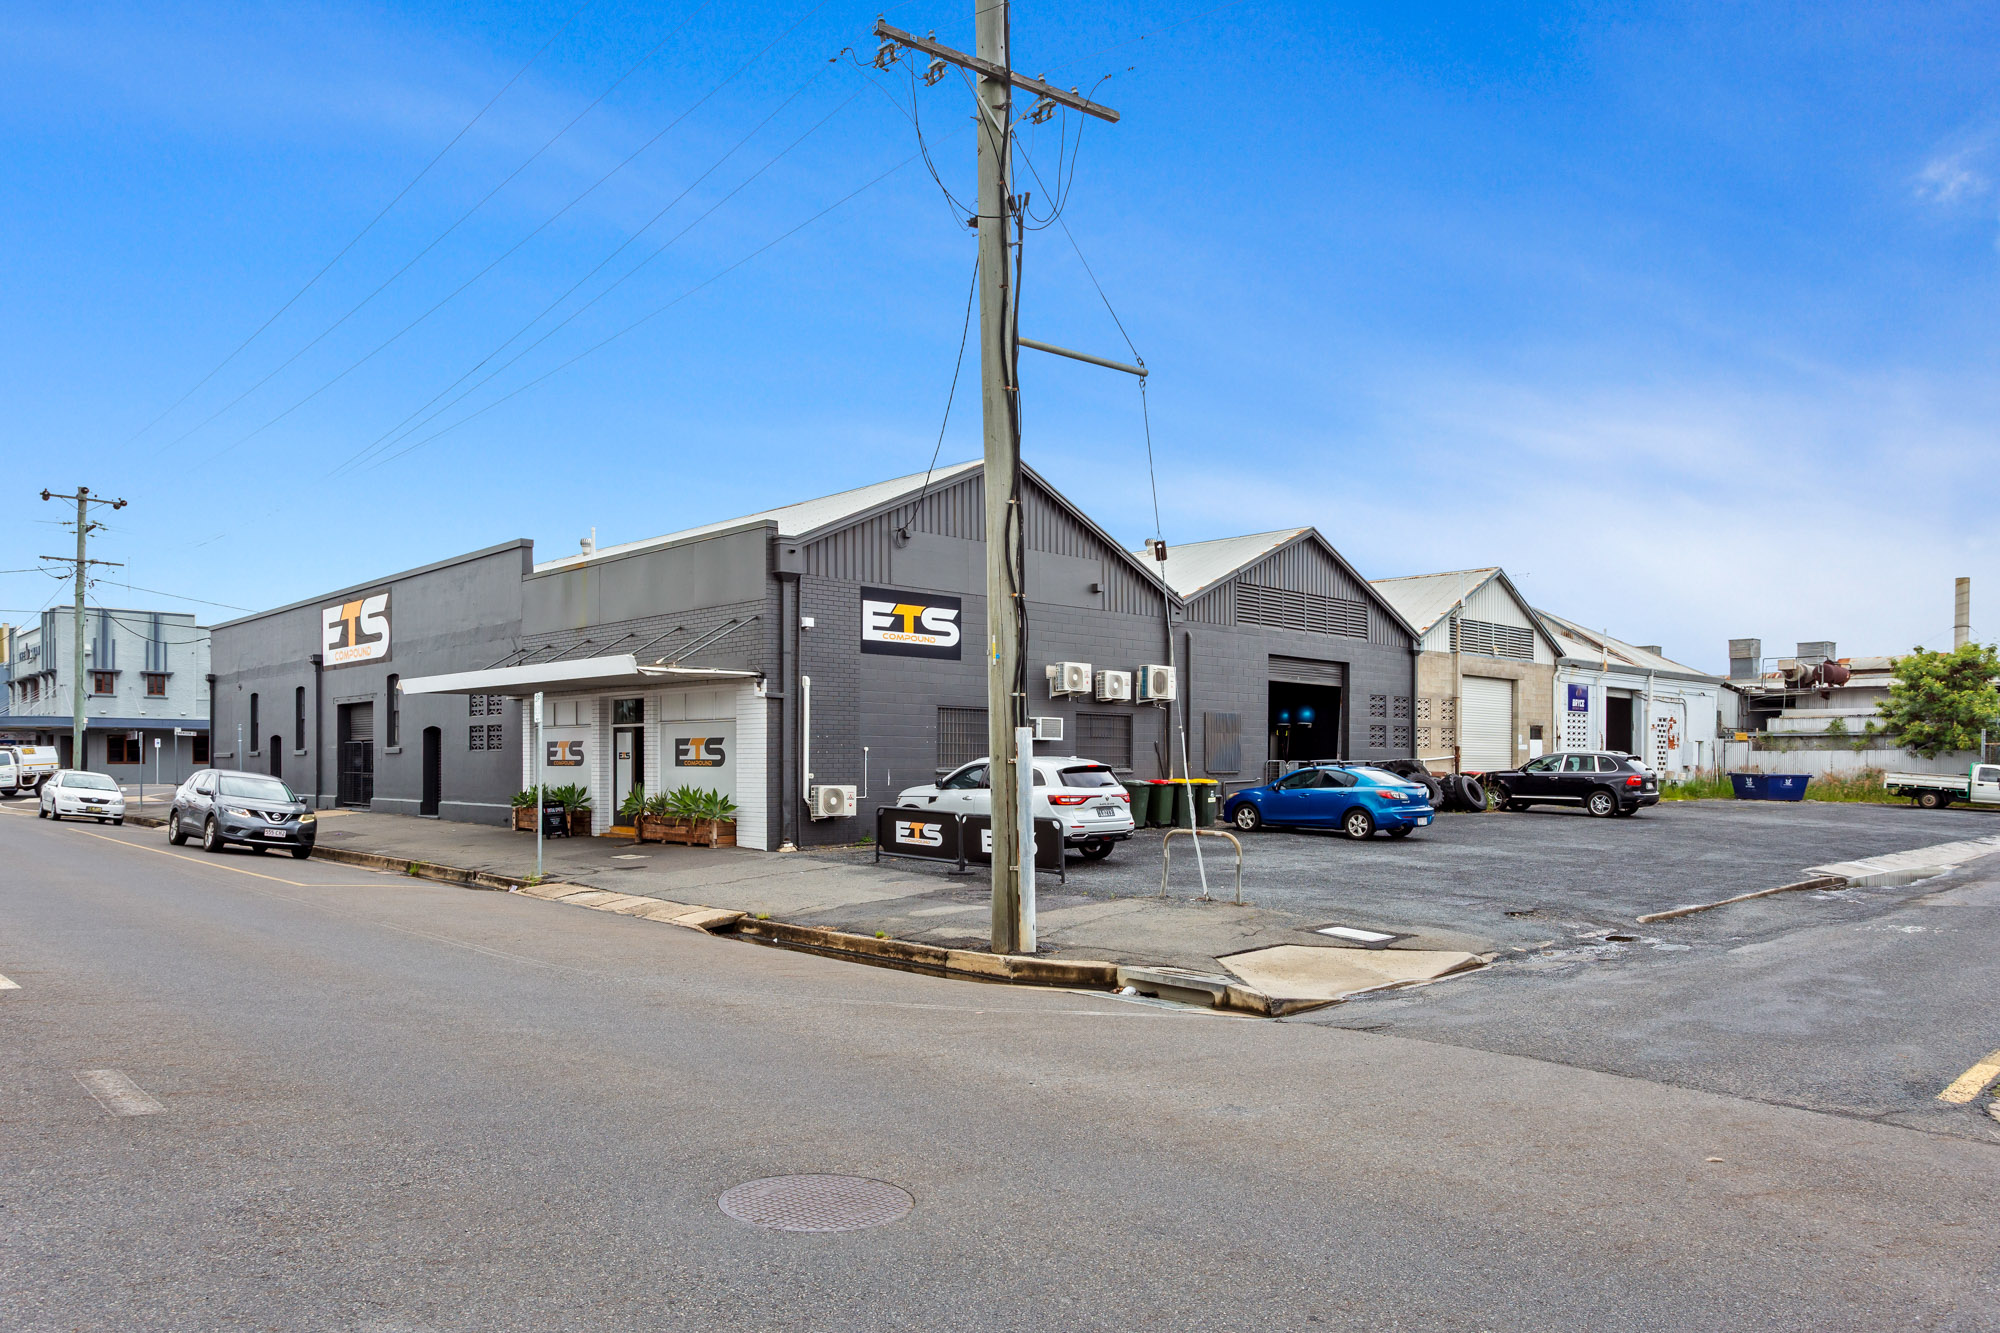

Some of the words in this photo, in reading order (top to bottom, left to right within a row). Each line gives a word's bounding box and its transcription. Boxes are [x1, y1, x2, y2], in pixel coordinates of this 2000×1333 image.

[322, 593, 390, 667] ETS
[862, 599, 960, 647] ETS
[882, 632, 937, 644] COMPOUND
[334, 645, 372, 661] COMPOUND
[546, 740, 585, 767] ETS
[618, 751, 631, 760] ETS
[674, 736, 726, 768] ETS
[895, 820, 943, 848] ETS
[904, 837, 931, 845] COMPOUND
